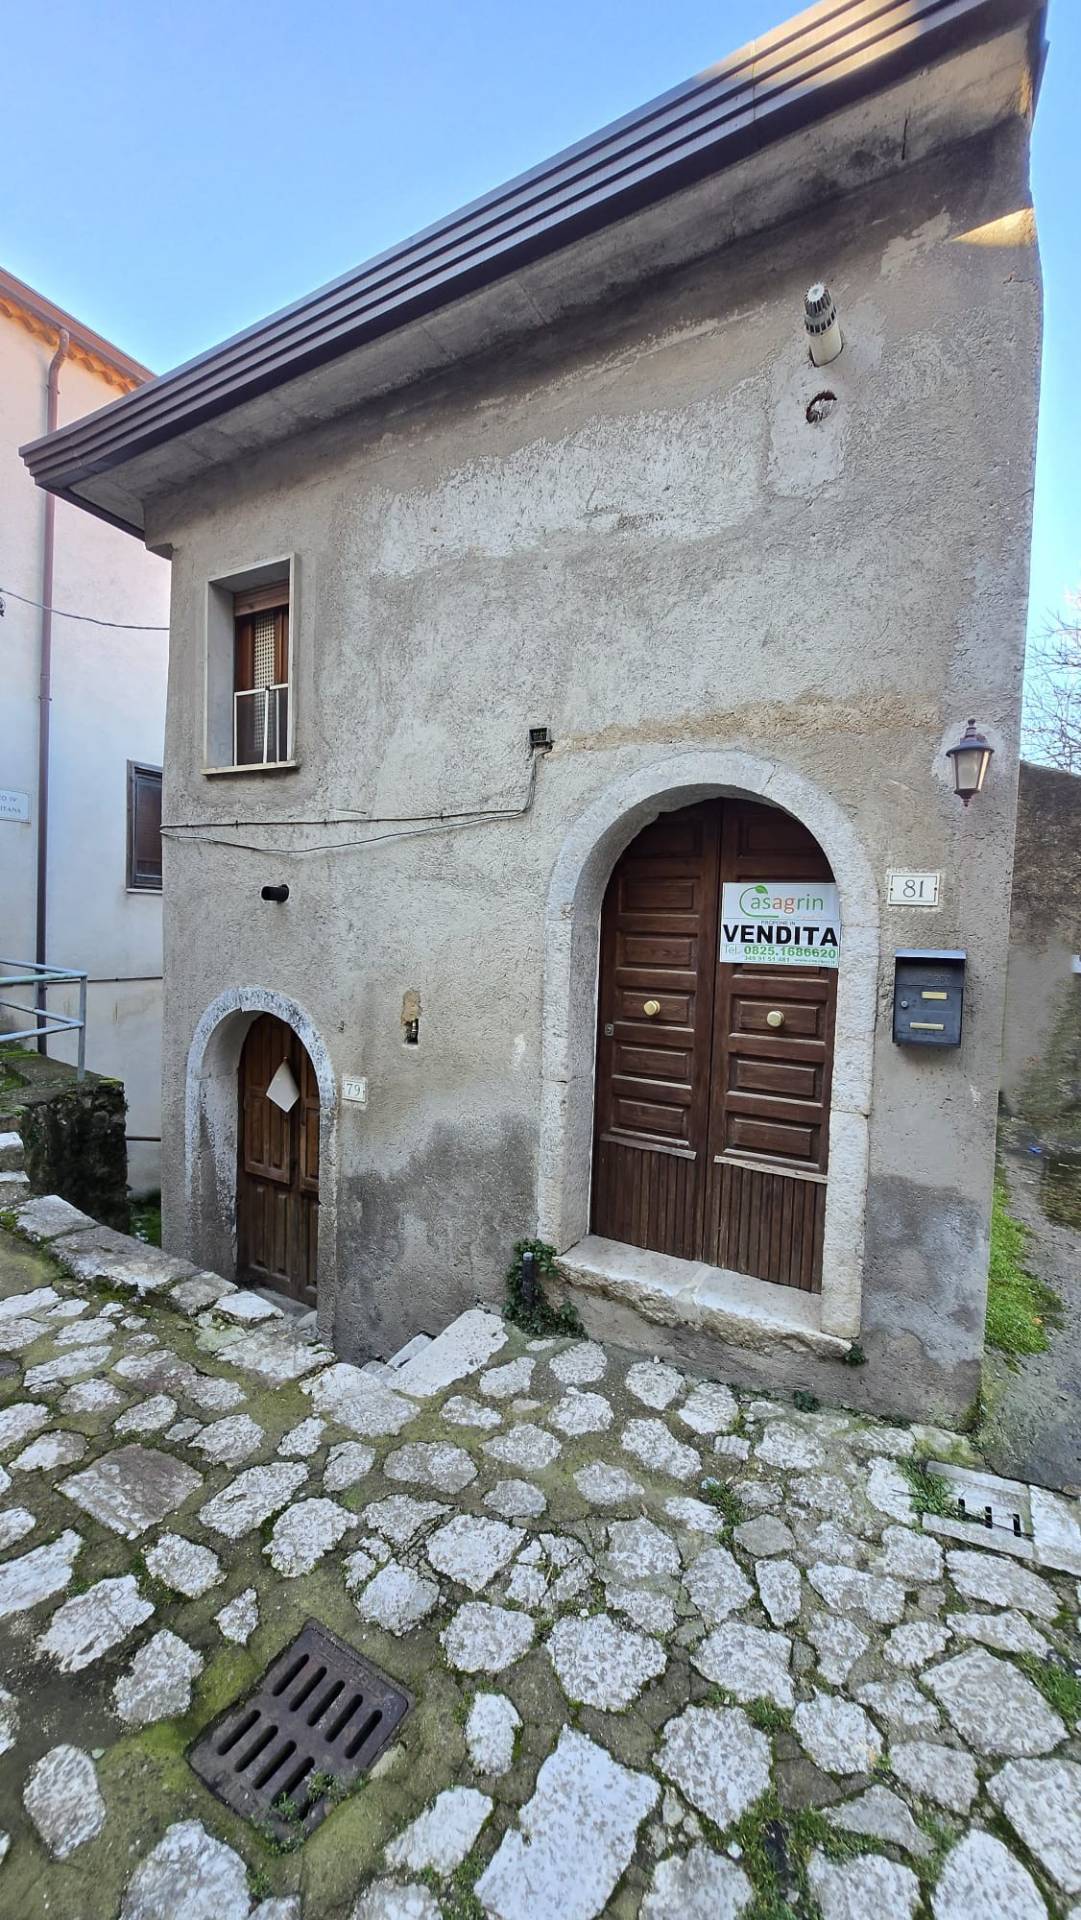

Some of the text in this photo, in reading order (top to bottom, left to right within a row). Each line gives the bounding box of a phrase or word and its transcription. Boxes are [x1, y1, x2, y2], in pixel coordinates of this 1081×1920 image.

[903, 879, 924, 898] 81
[740, 885, 824, 918] Casagrin
[723, 924, 838, 946] VENDITA
[744, 946, 836, 959] 0825.1686620
[346, 1083, 361, 1096] 79
